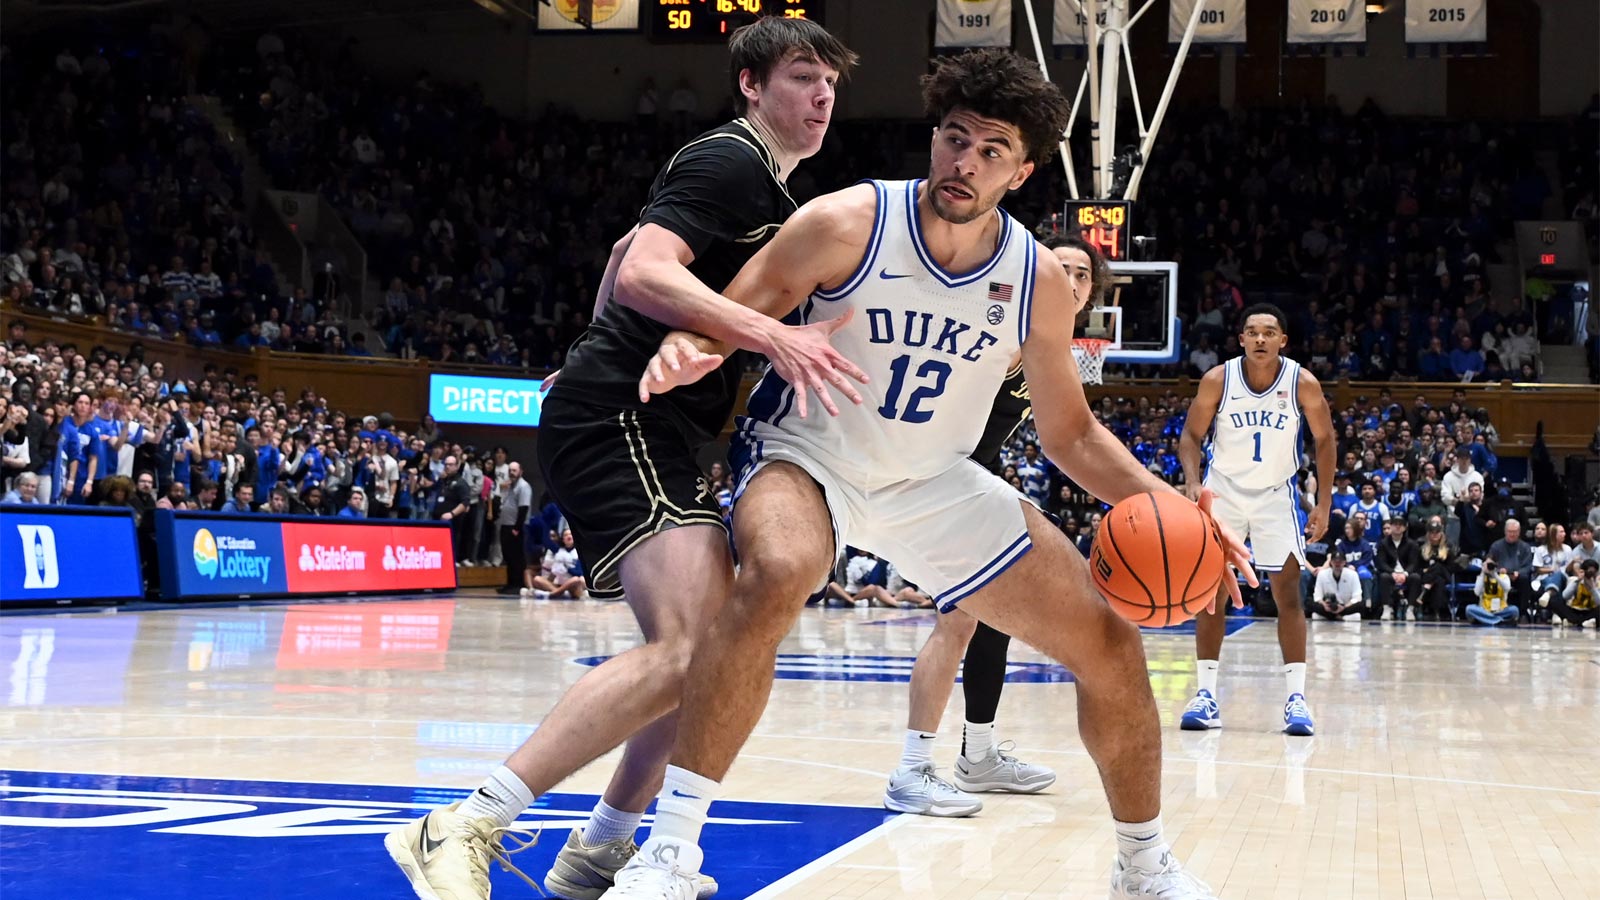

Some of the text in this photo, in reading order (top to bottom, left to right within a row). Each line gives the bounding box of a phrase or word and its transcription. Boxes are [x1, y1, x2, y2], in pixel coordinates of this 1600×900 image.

[668, 10, 691, 29] 50
[957, 14, 991, 27] 1991
[1200, 9, 1225, 24] 001
[1310, 9, 1346, 23] 2010
[1428, 8, 1466, 22] 2015
[1078, 206, 1124, 226] 16:40
[866, 308, 998, 362] DUKE
[877, 354, 953, 424] 12
[1230, 410, 1288, 430] DUKE
[1252, 431, 1262, 462] 1
[216, 536, 227, 549] NC
[218, 550, 271, 584] Lottery
